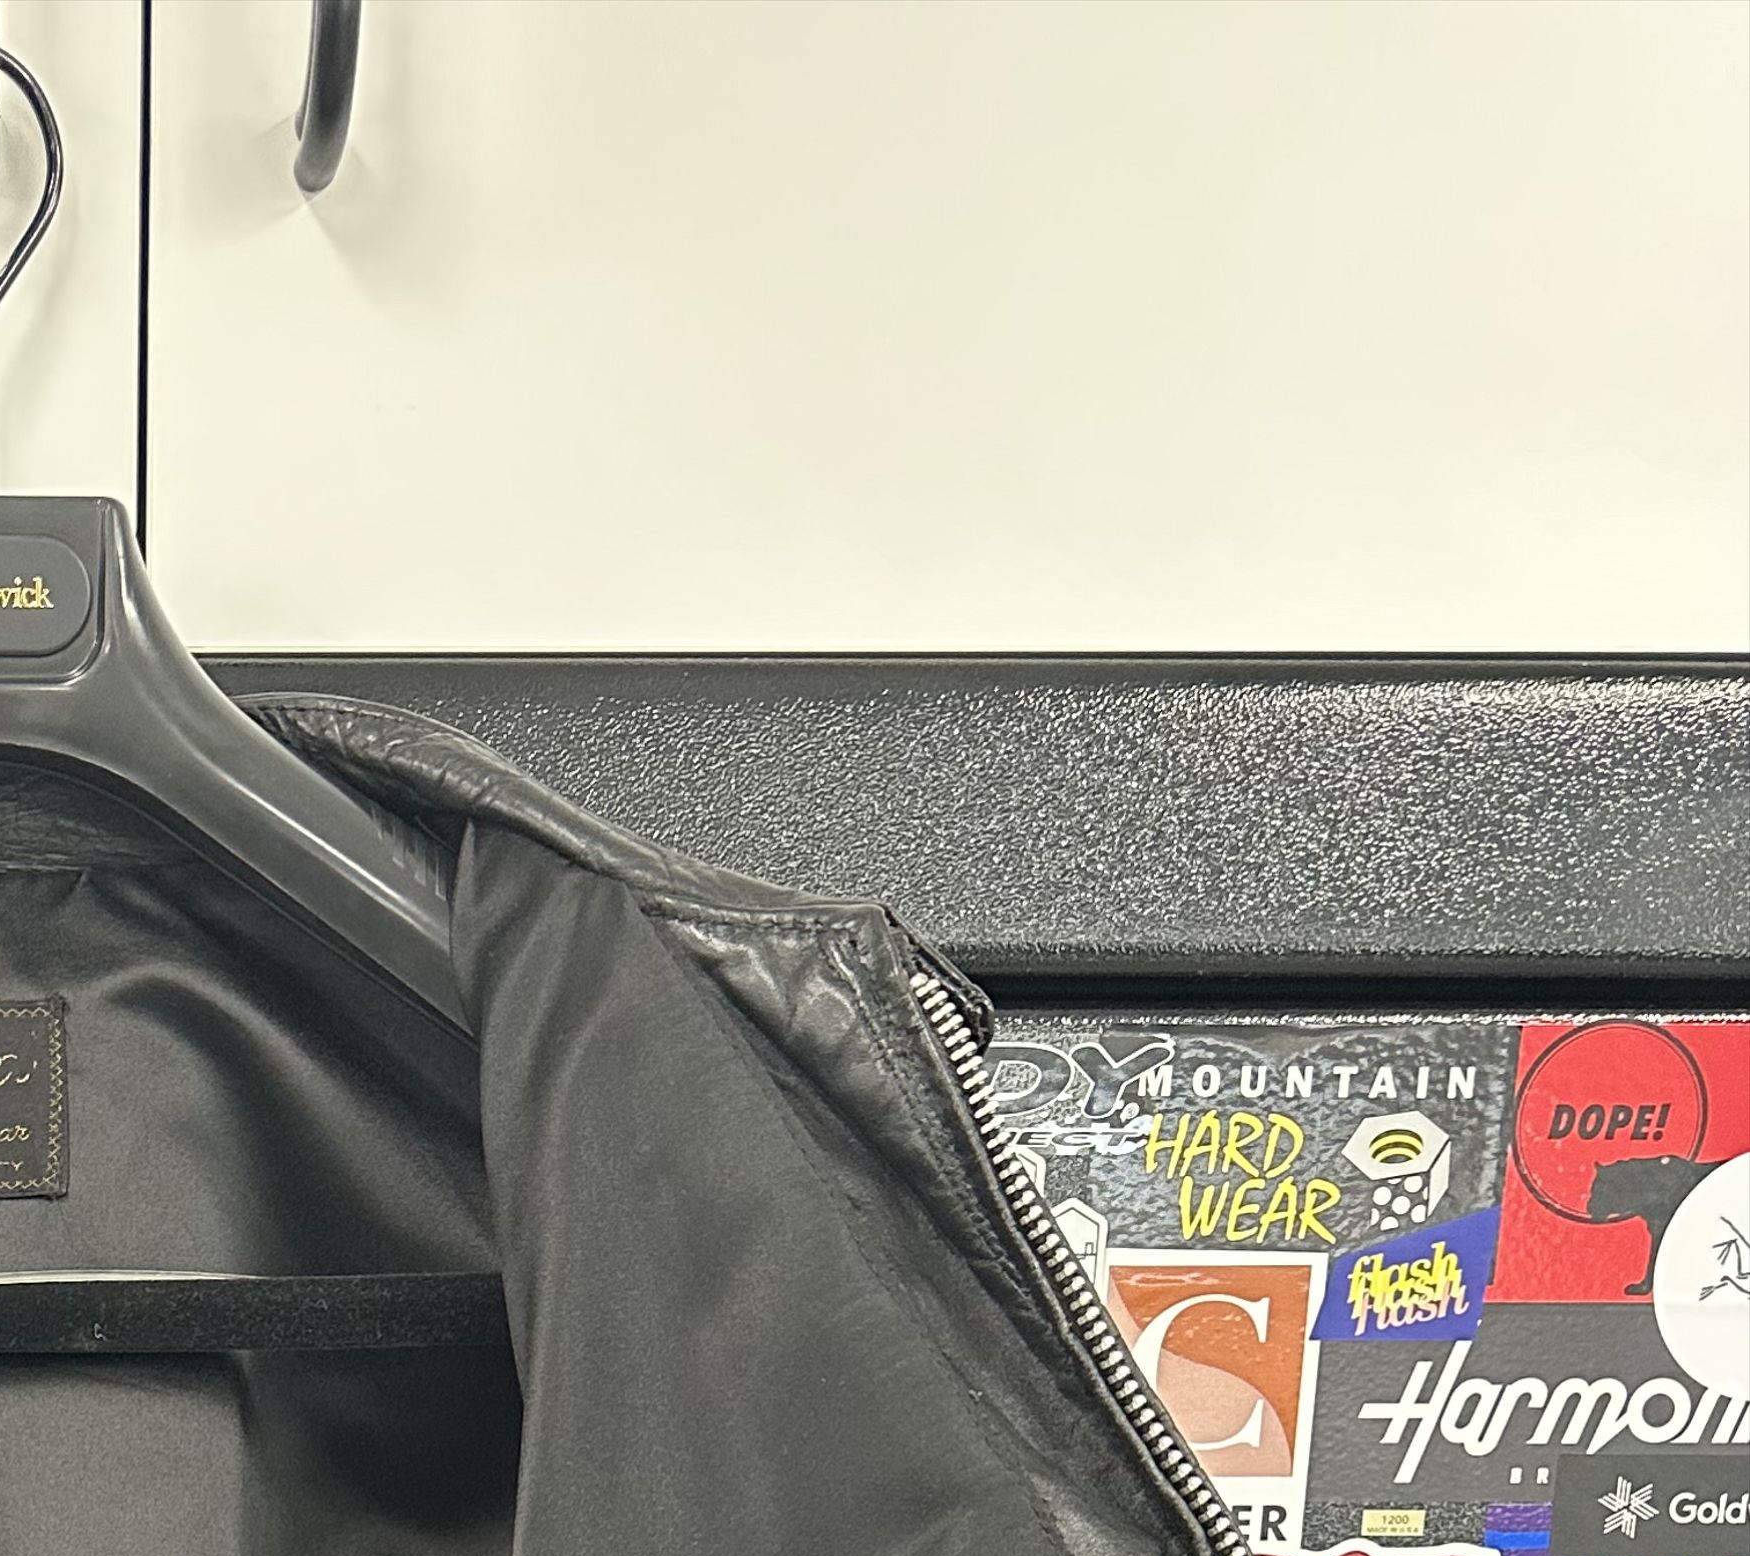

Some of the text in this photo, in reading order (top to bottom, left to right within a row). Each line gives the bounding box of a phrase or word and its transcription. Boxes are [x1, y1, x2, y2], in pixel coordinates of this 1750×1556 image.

[1138, 1064, 1477, 1099] MOUNTAIN
[1145, 1109, 1304, 1181] HARD
[1548, 1102, 1672, 1142] DOPE!
[1179, 1176, 1344, 1244] WEAR
